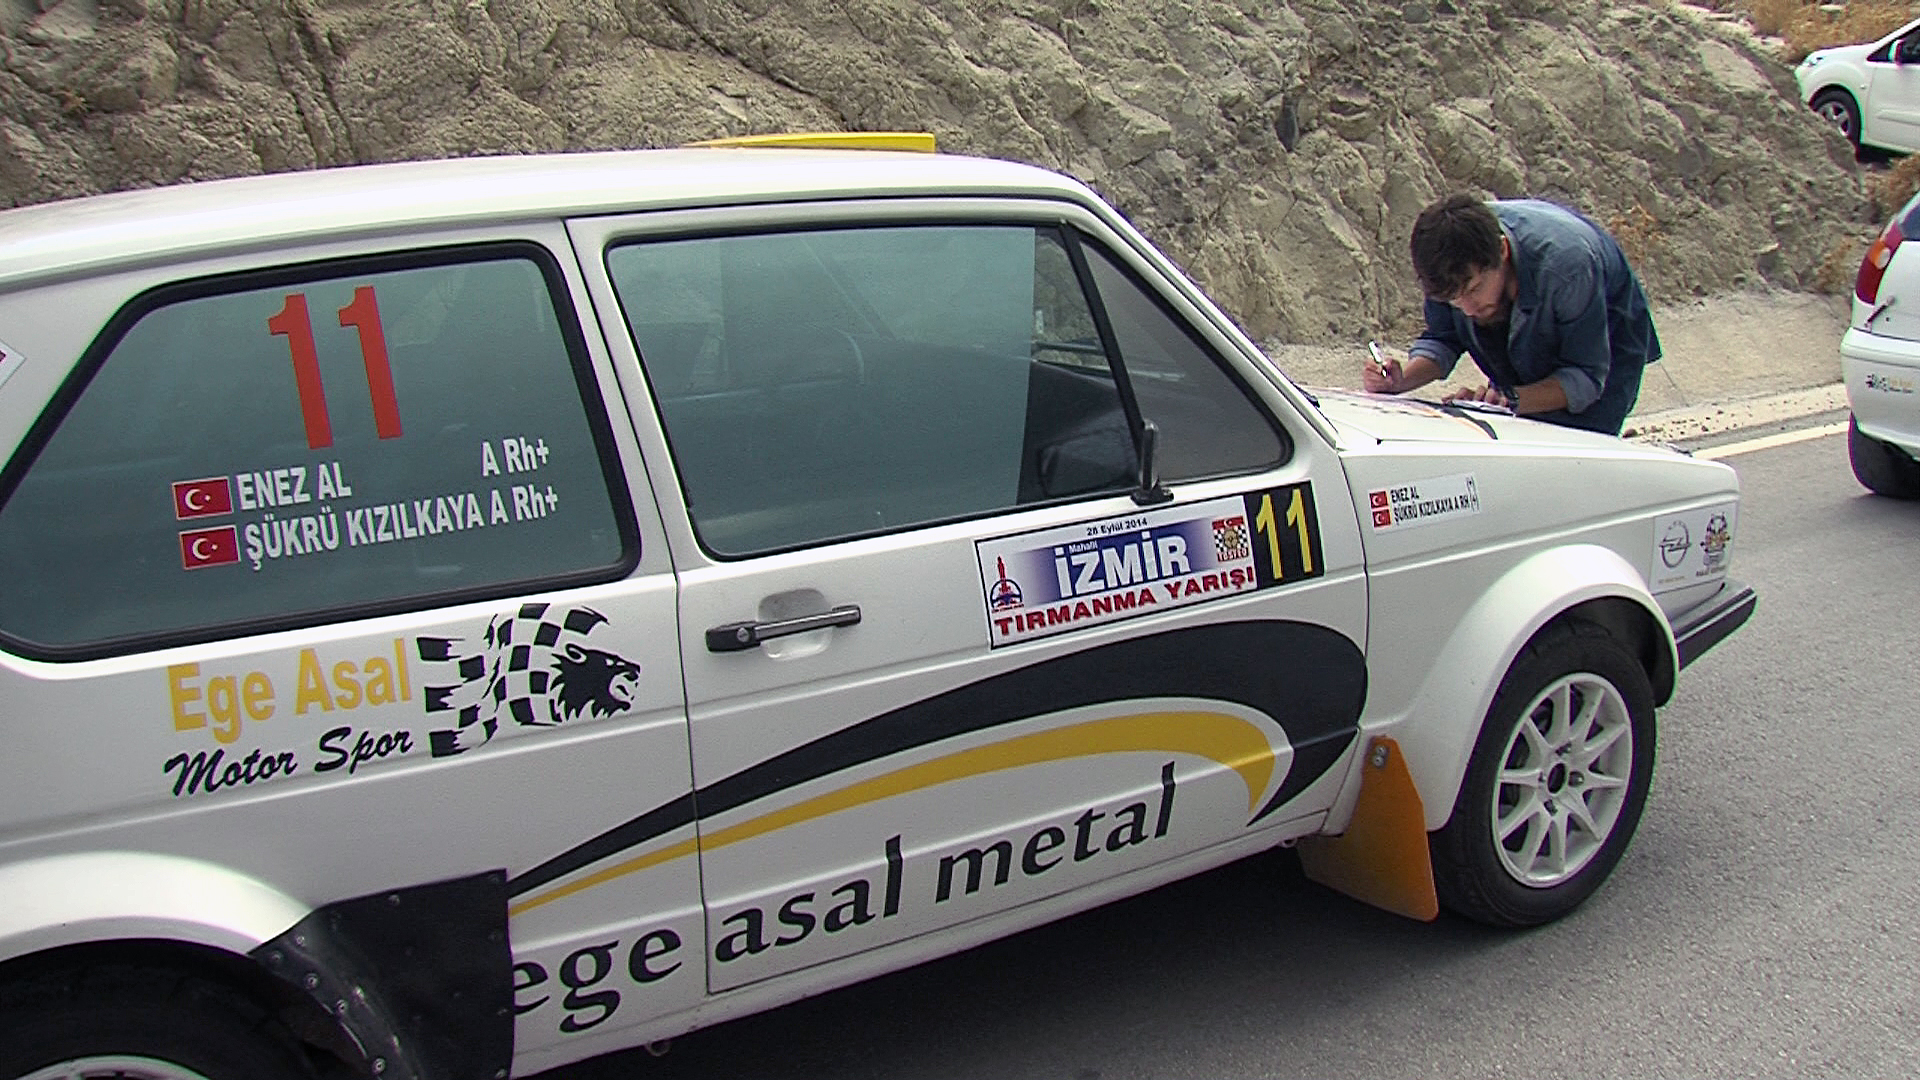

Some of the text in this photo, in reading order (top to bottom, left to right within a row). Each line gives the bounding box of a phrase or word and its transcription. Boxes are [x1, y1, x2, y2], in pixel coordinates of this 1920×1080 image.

[268, 285, 403, 450] 11
[235, 435, 550, 511] ENEZ AL A Rh+
[245, 484, 559, 571] ŞÜKRÜ KIZILKAYA A Rh+
[1054, 530, 1192, 598] İZMİR
[1125, 517, 1148, 530] 2014
[1256, 488, 1313, 581] 11
[994, 566, 1255, 637] TIRMANMA YARIŞI
[165, 637, 413, 745] Ege Asal
[163, 726, 414, 798] Motor Spor
[513, 761, 1177, 1034] ege asal metal
